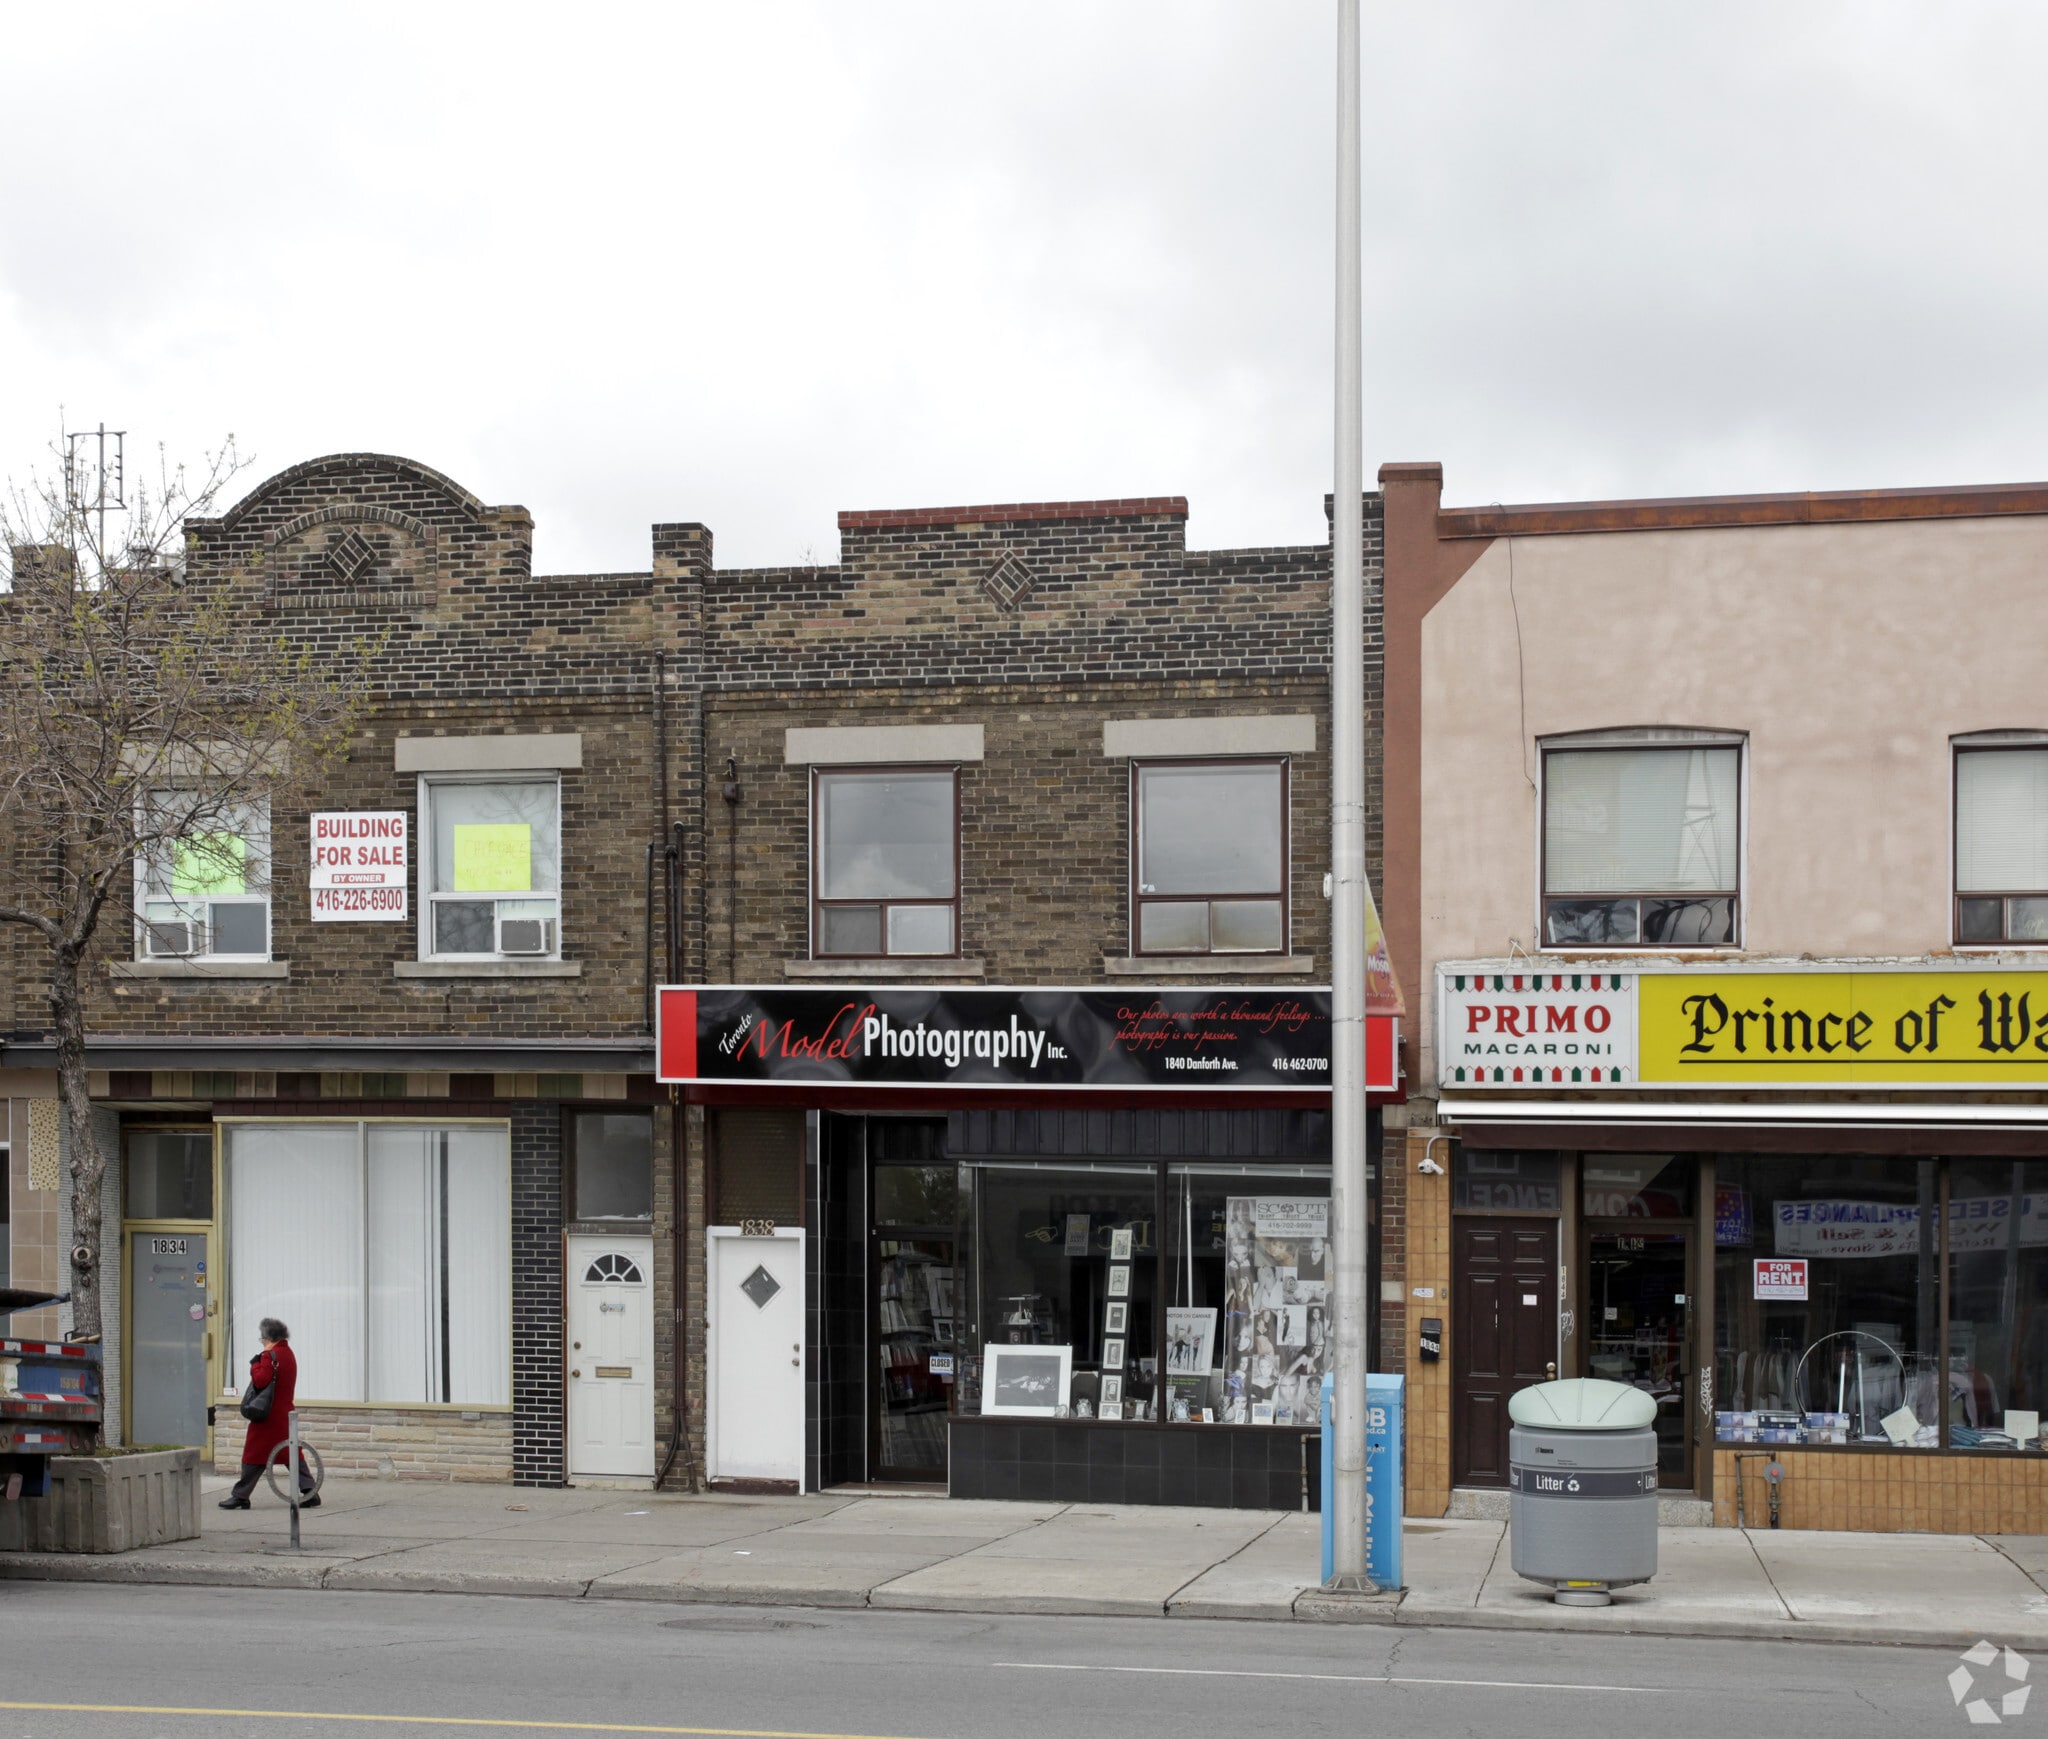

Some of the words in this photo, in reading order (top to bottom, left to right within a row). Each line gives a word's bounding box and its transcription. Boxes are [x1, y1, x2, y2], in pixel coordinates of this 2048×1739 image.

[317, 818, 403, 838] BUILDING
[316, 846, 351, 866] FOR
[357, 846, 403, 865] SALE
[348, 874, 382, 882] OWNER
[316, 889, 403, 911] 416-226-6900
[1117, 1007, 1139, 1019] Our
[1134, 1001, 1170, 1031] photos
[1190, 1001, 1227, 1020] worth
[1231, 1001, 1281, 1020] thousand
[1260, 1001, 1311, 1033] feelings
[1465, 1005, 1611, 1037] PRIMO
[1680, 992, 1873, 1054] Prince
[1895, 993, 1957, 1054] of
[718, 1013, 752, 1055] Toronto
[736, 1003, 877, 1062] Model
[864, 1013, 1046, 1068] Photography
[1047, 1042, 1068, 1059] Inc.
[1108, 1021, 1174, 1051] photography
[1172, 1029, 1180, 1039] is
[1184, 1031, 1200, 1039] our
[1194, 1029, 1238, 1051] passion.
[1464, 1043, 1611, 1054] MACARONI
[1165, 1057, 1185, 1070] 1840
[1187, 1056, 1220, 1070] Danforth
[1222, 1057, 1239, 1070] Ave.
[1272, 1058, 1288, 1070] 416
[1289, 1058, 1328, 1070] 462-0700
[739, 1219, 775, 1237] 1838
[152, 1239, 186, 1254] 1834
[1769, 1263, 1792, 1272] FOR
[1758, 1271, 1803, 1285] RENT
[931, 1358, 951, 1368] CLOSED
[1535, 1474, 1565, 1491] Litter
